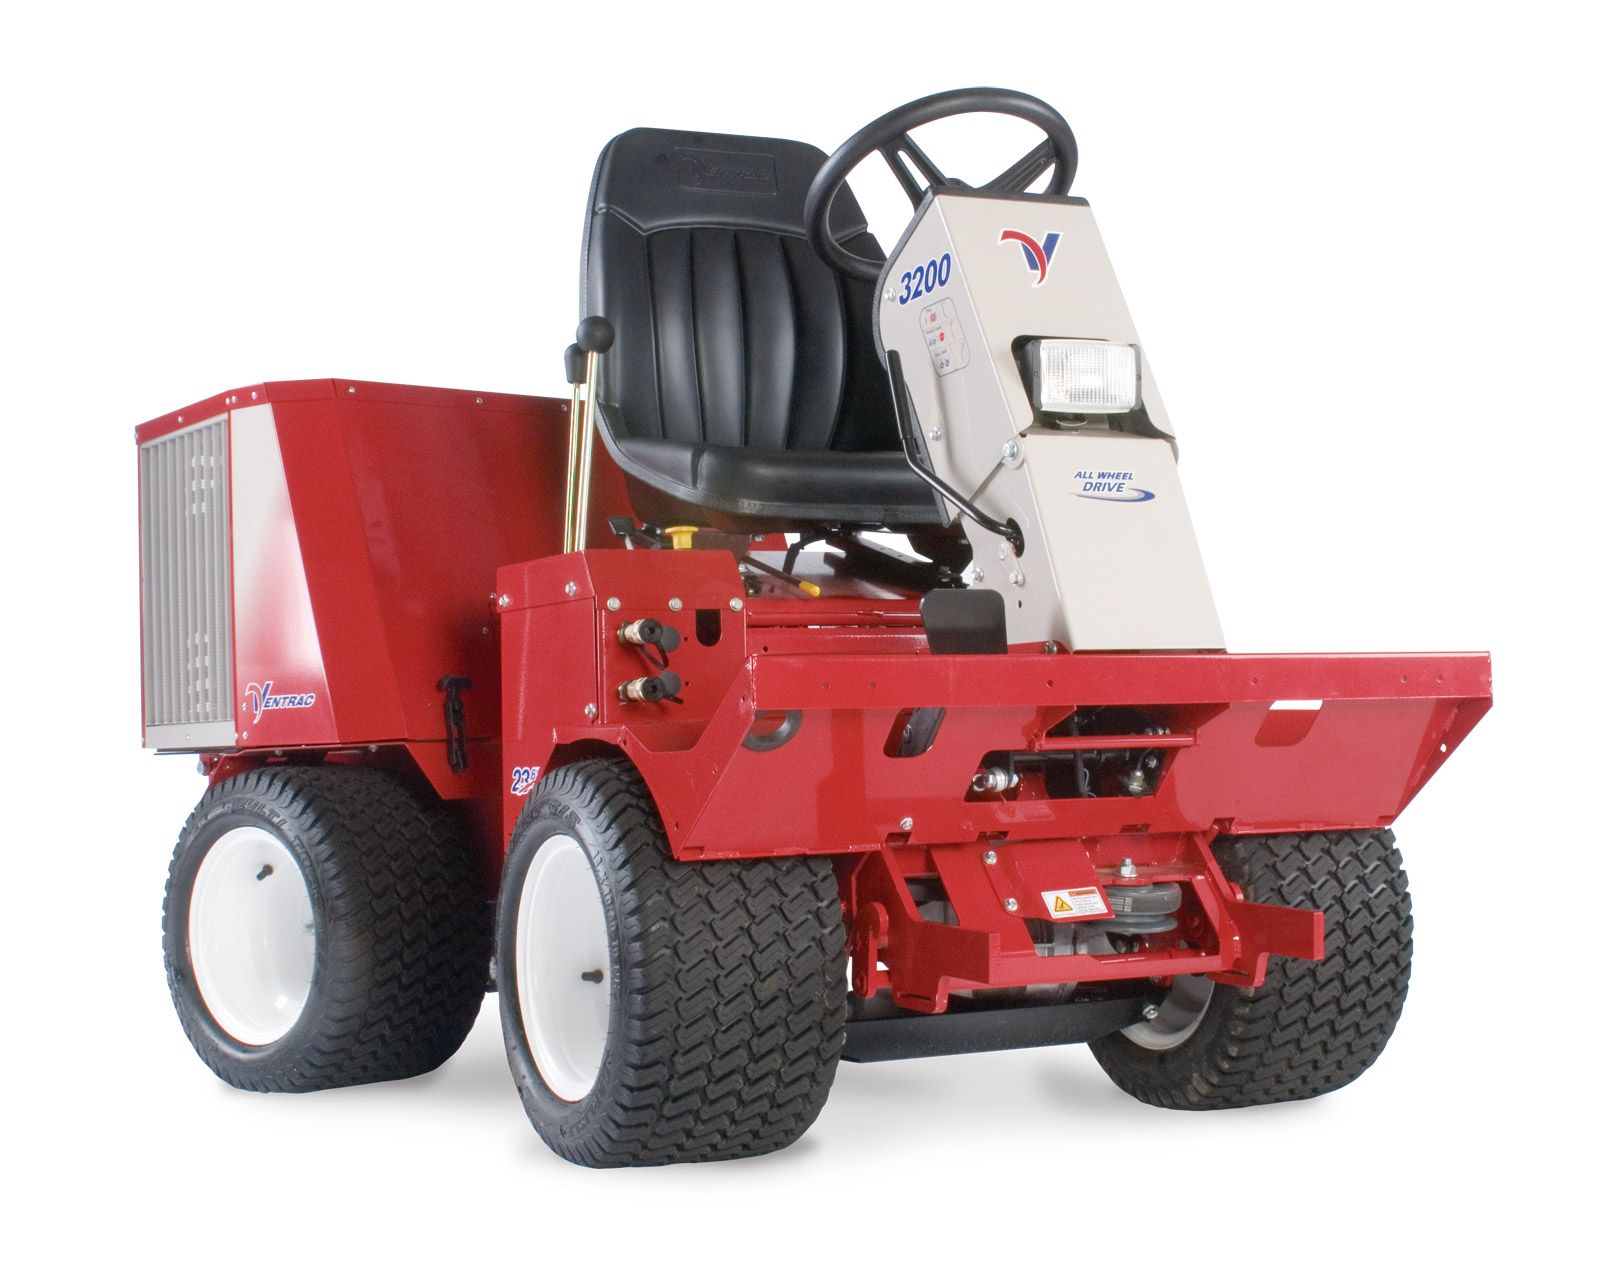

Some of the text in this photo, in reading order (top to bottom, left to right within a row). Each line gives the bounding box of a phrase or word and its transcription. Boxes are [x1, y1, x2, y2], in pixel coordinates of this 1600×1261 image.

[899, 252, 952, 306] 3200
[1073, 470, 1134, 481] ALL WHEEL
[1081, 481, 1126, 493] DRIVE
[245, 681, 315, 724] VENTRAC
